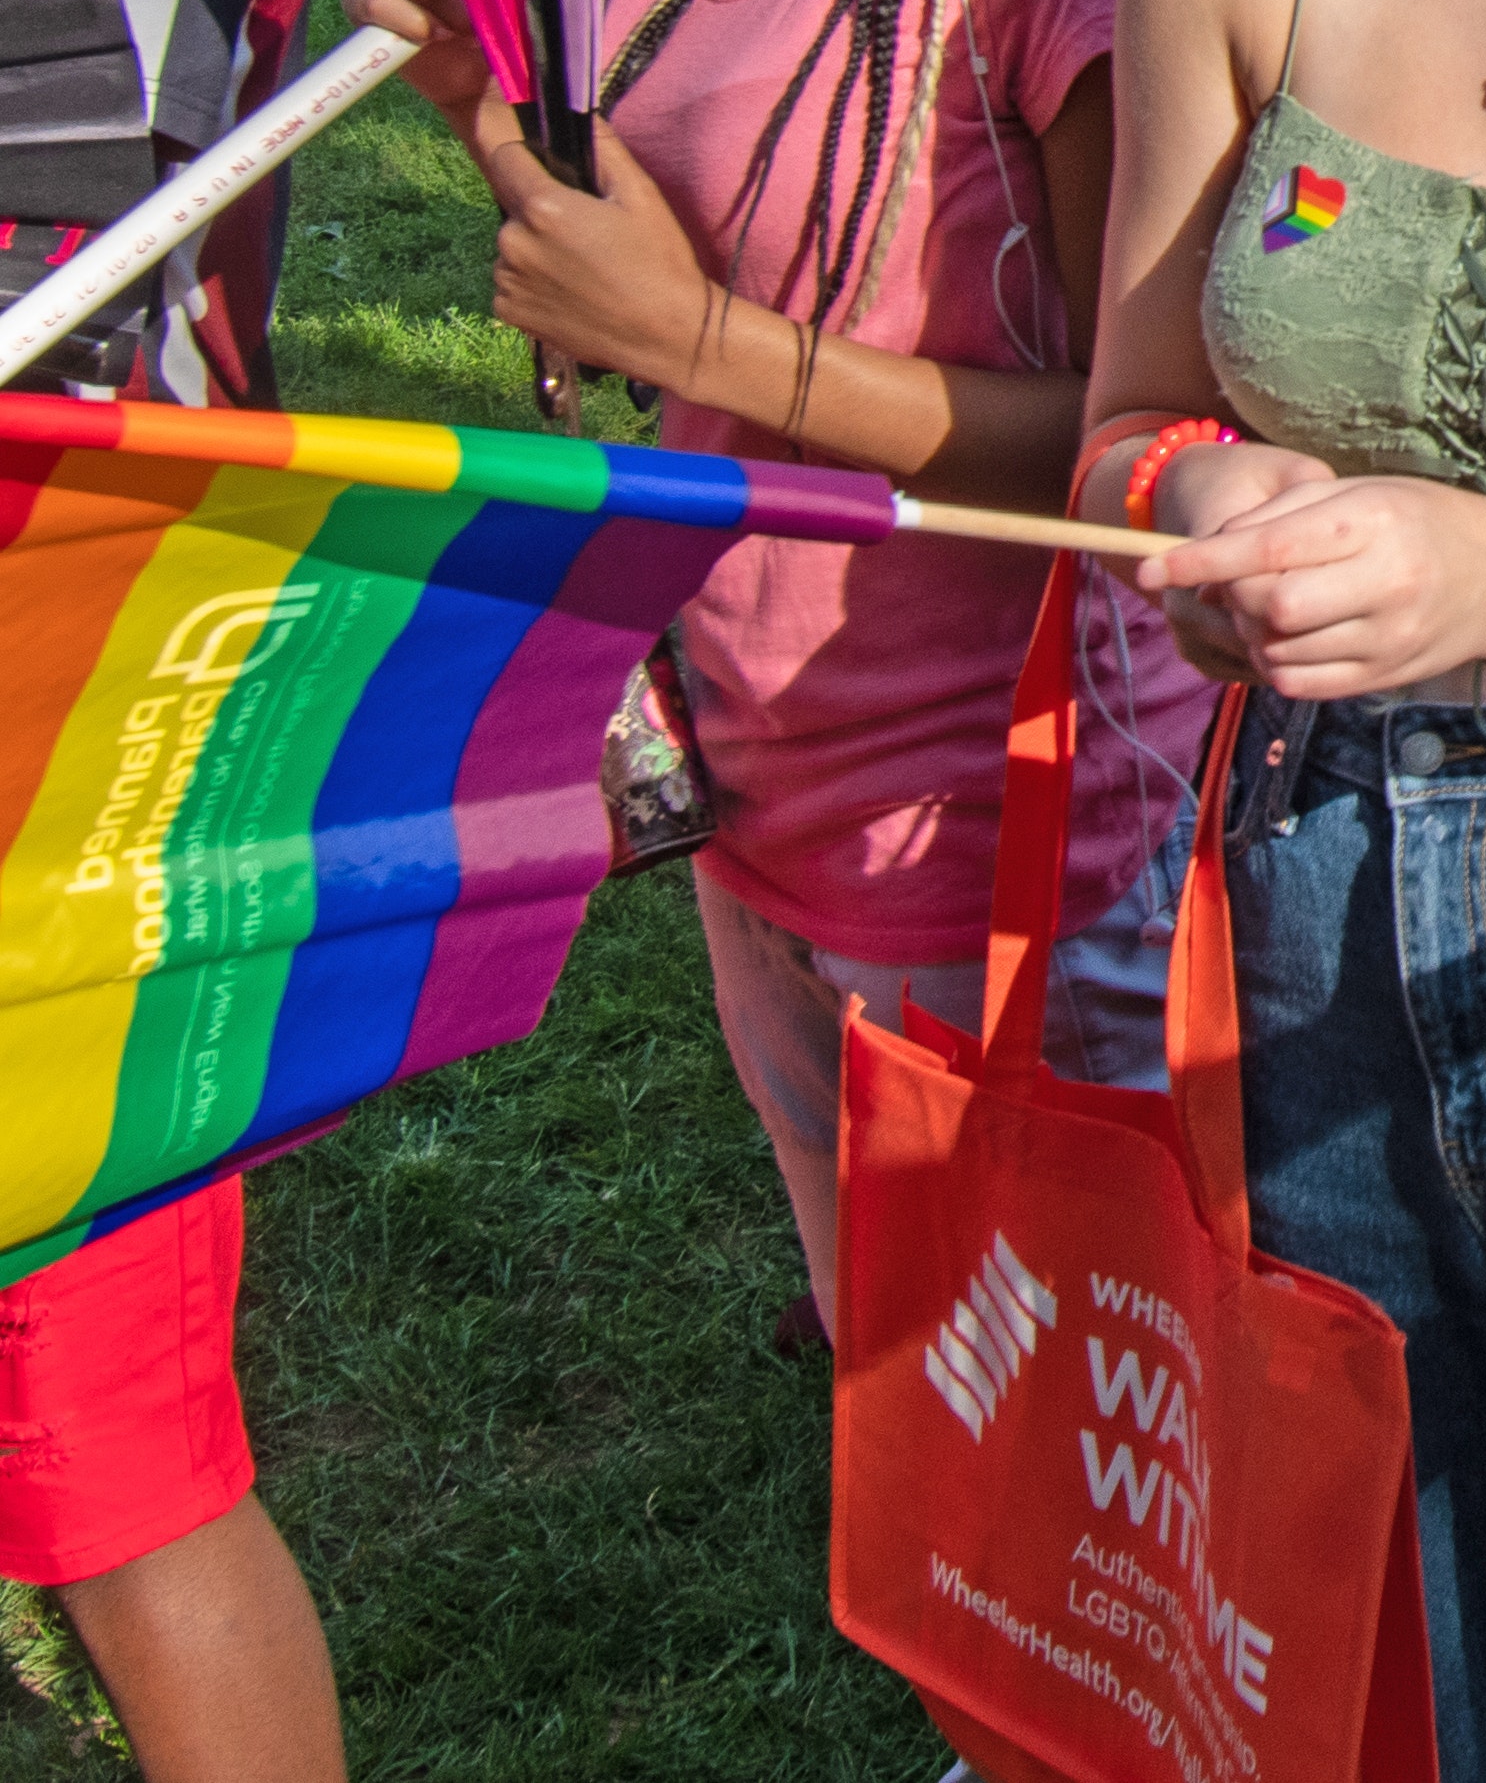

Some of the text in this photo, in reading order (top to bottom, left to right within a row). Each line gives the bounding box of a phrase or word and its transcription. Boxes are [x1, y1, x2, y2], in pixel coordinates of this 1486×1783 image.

[258, 111, 307, 155] MADE
[229, 152, 256, 178] IN
[1206, 1569, 1275, 1716] ME
